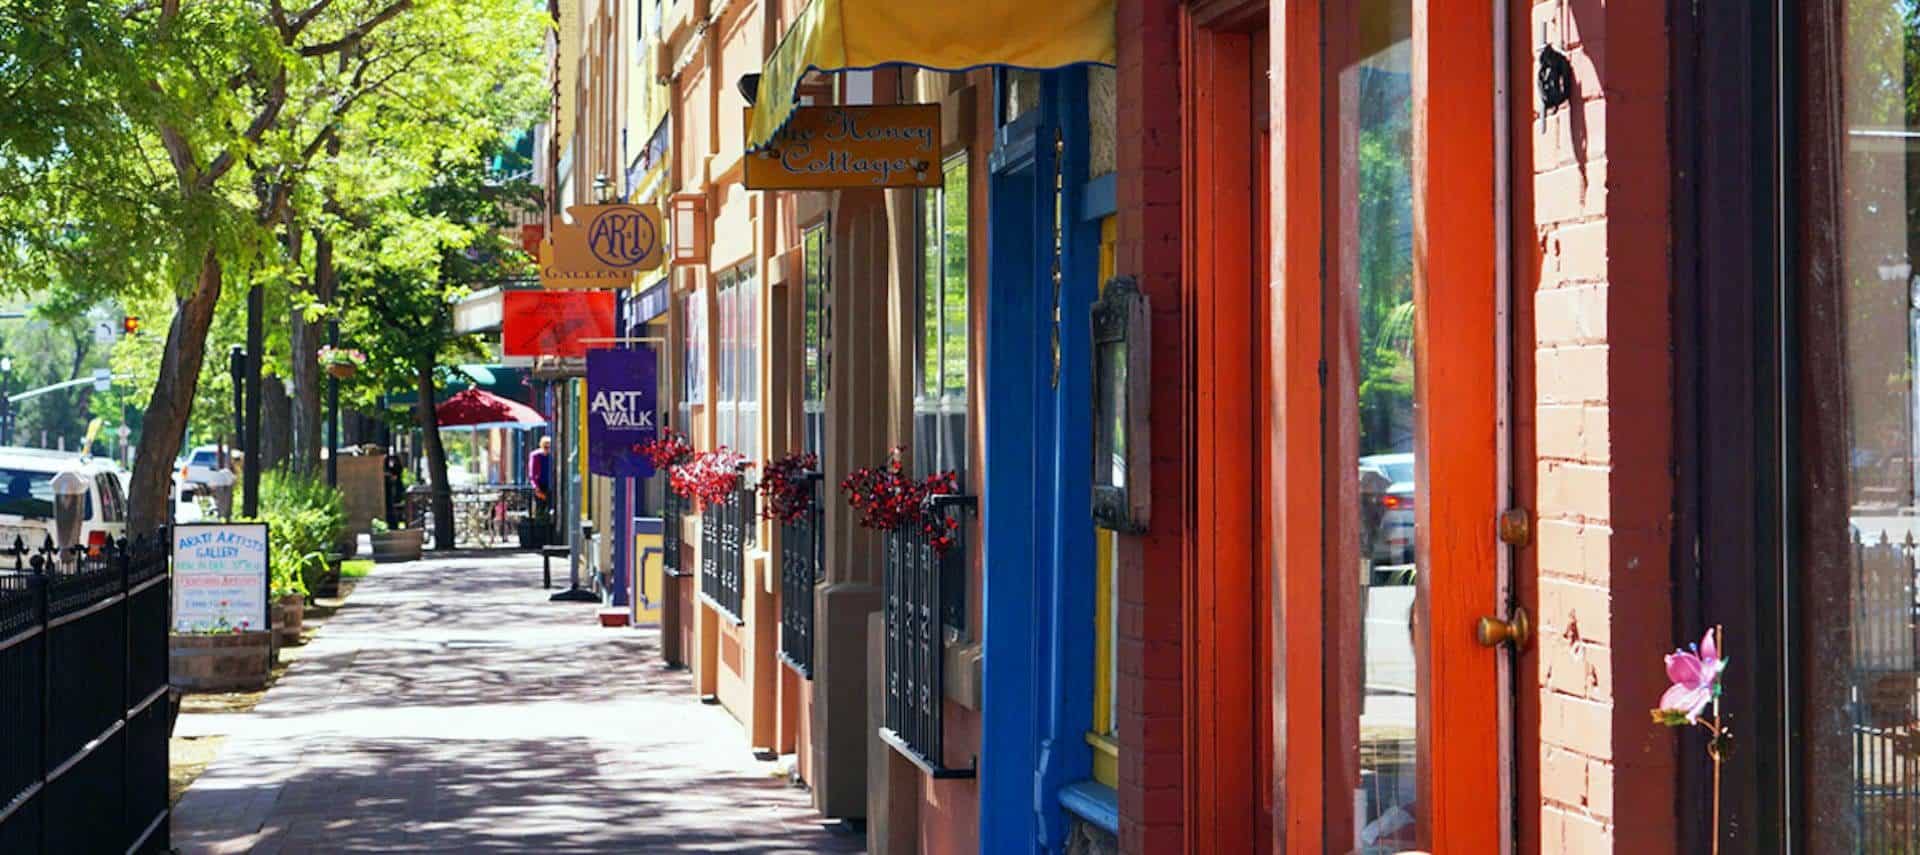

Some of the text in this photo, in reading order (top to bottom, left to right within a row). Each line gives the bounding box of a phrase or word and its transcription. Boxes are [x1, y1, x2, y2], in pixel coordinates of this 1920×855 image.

[824, 109, 932, 151] Honey
[780, 143, 906, 185] Cottage
[592, 391, 642, 413] ART
[601, 411, 653, 426] WALK
[196, 546, 239, 558] GALLERY
[216, 530, 265, 552] ARTISTS
